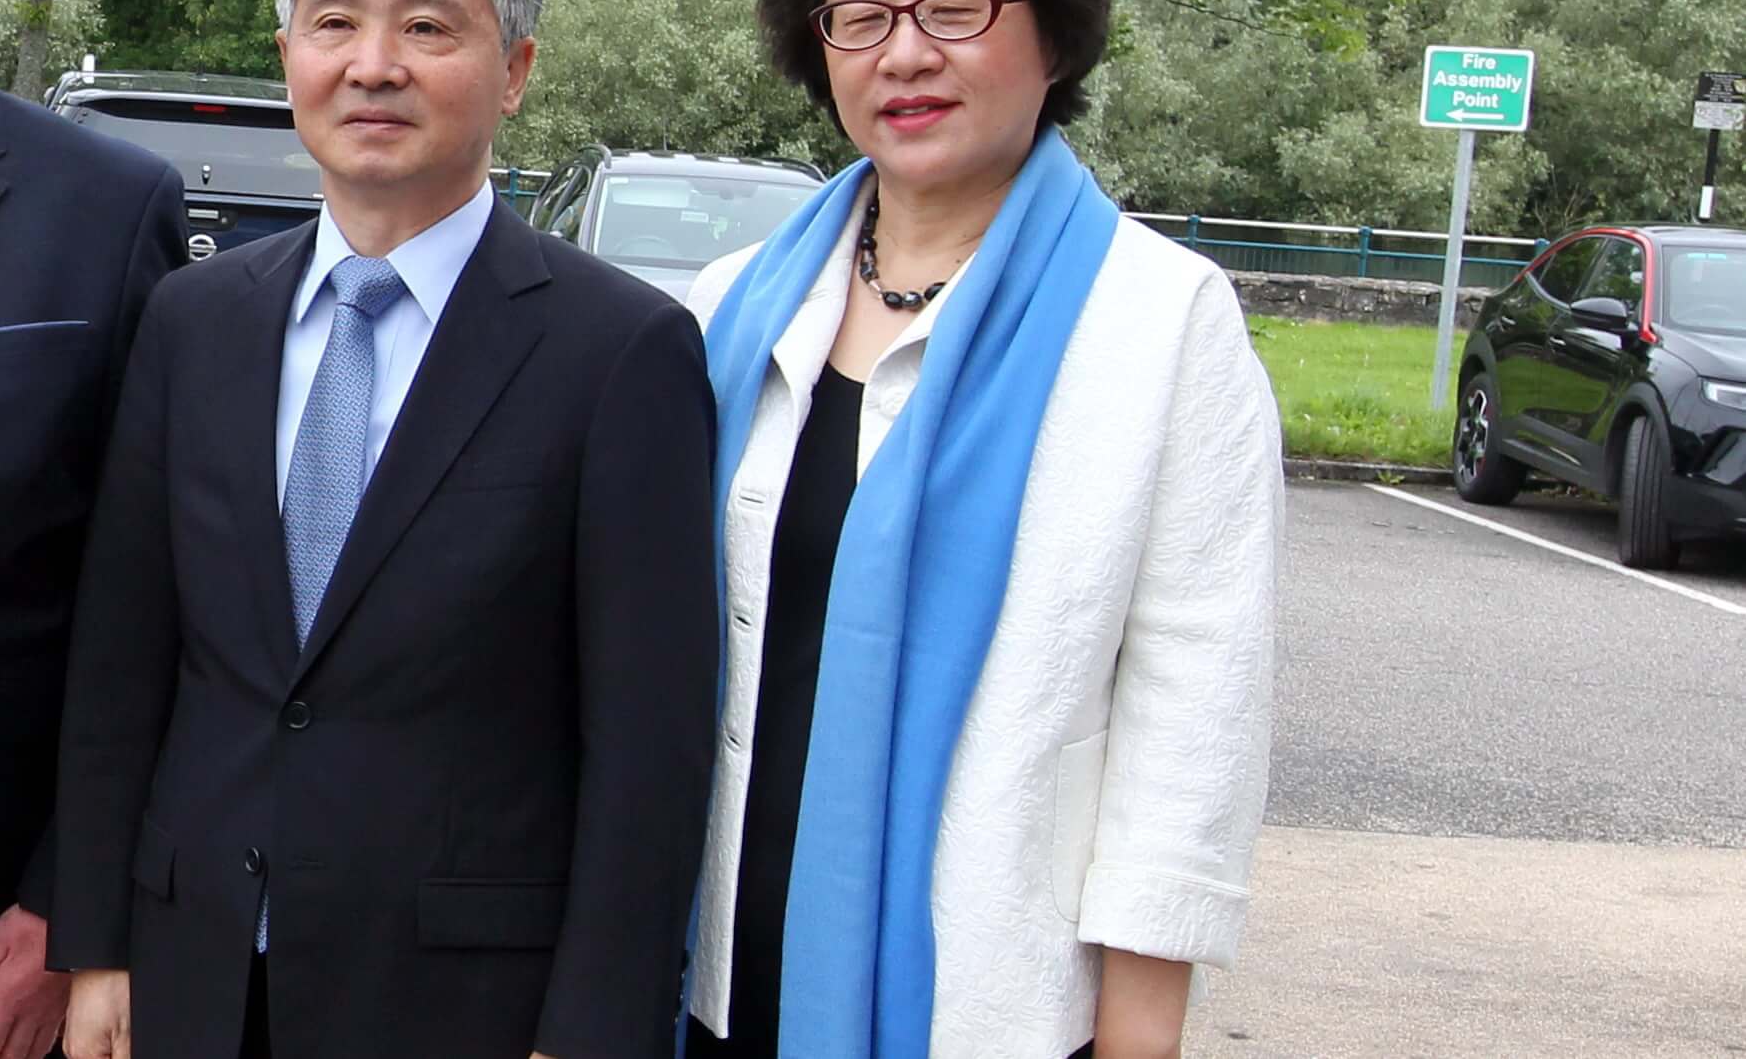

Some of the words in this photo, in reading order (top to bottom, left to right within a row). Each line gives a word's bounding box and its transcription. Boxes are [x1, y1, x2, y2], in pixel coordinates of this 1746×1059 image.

[1462, 53, 1496, 70] Fire
[1433, 70, 1522, 93] Assembly
[1453, 90, 1500, 108] Point
